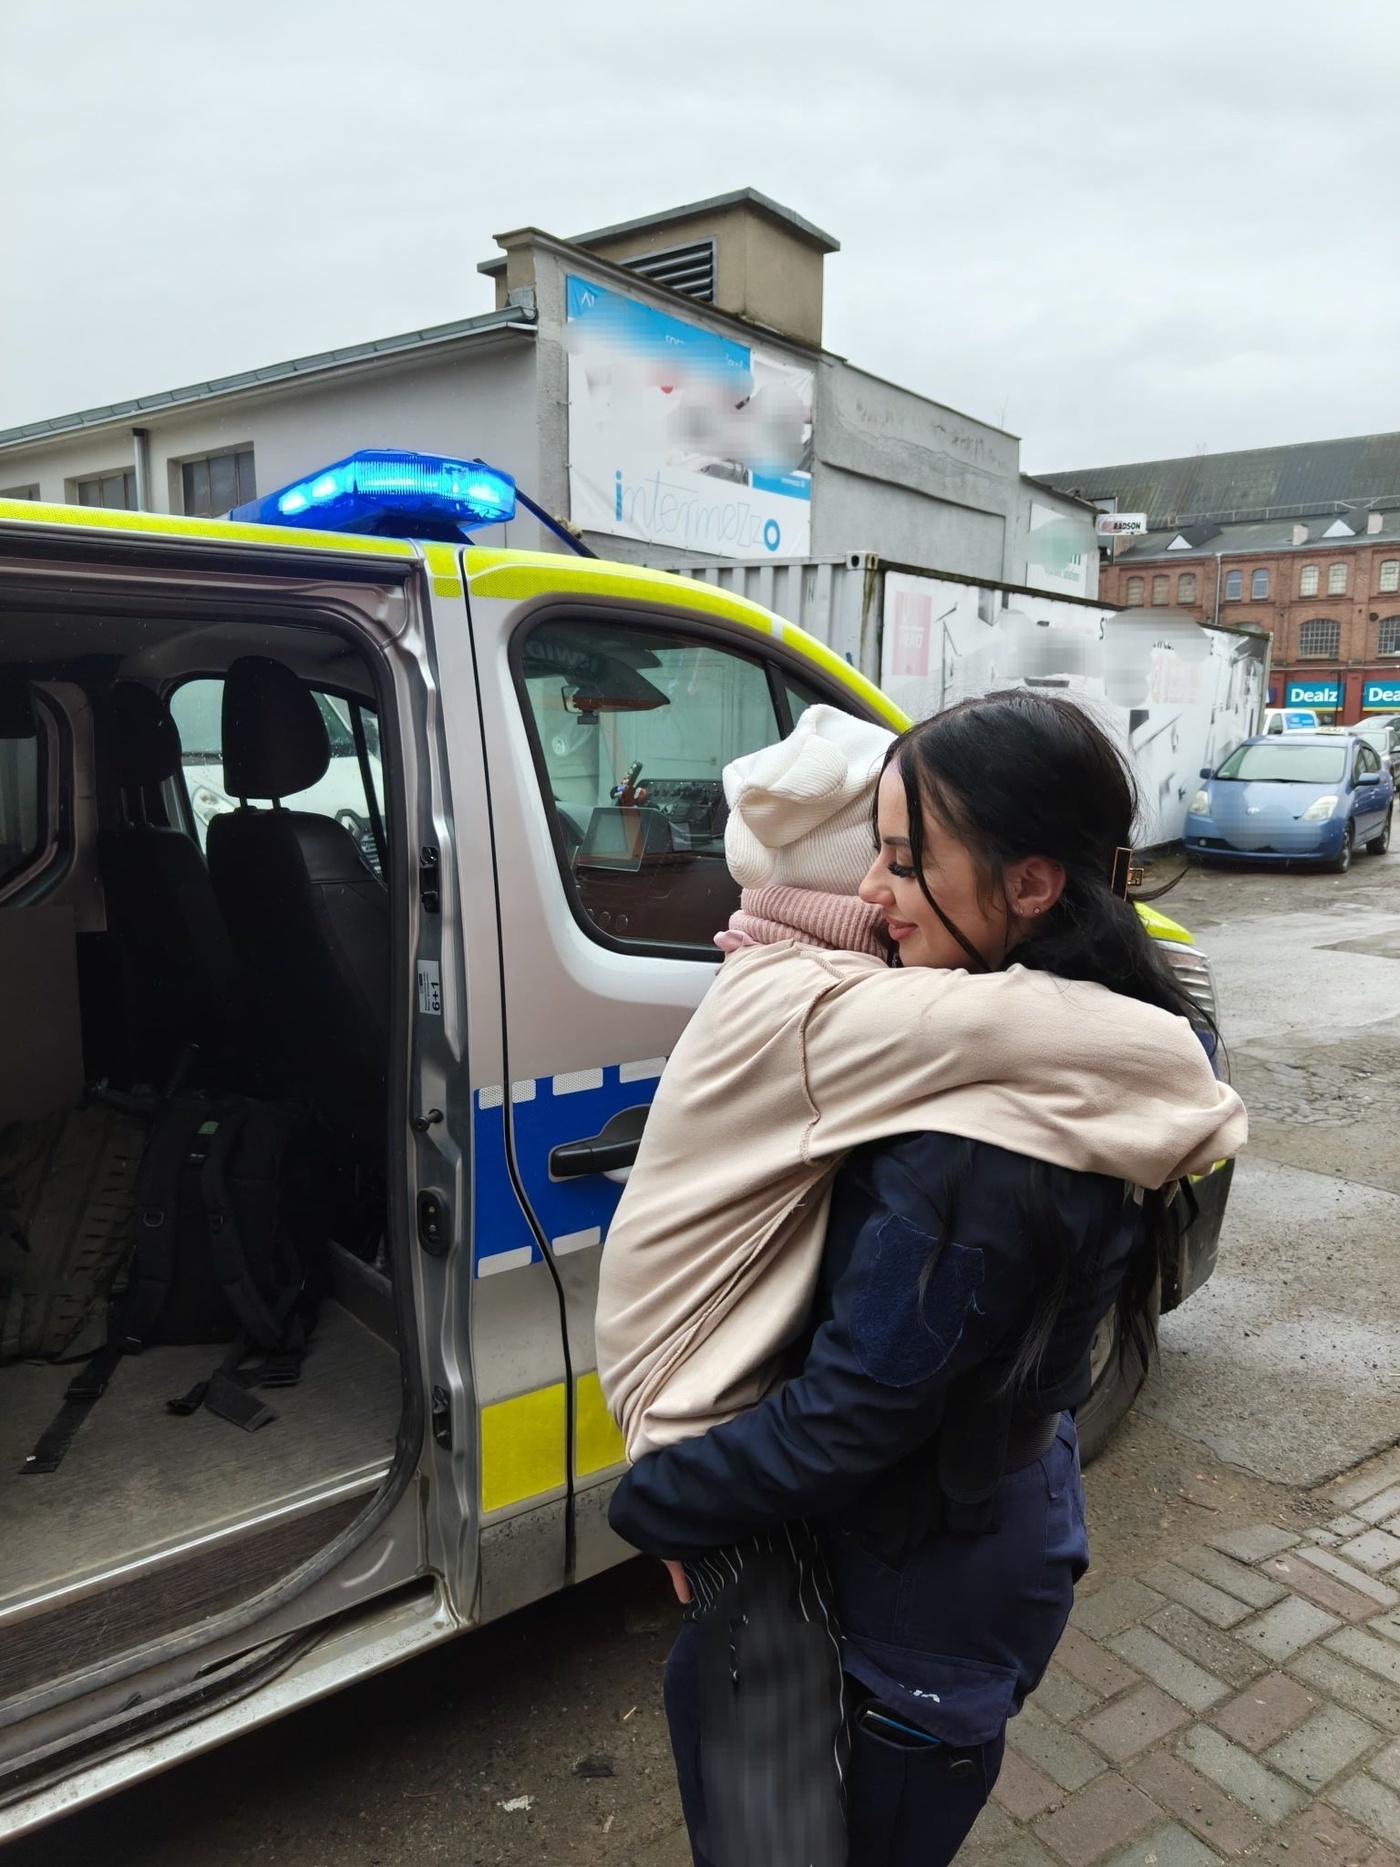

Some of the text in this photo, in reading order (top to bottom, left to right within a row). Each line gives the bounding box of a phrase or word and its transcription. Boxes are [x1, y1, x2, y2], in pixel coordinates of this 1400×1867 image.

[1113, 522, 1141, 530] RADSON
[1291, 688, 1338, 702] Dealz
[1368, 687, 1400, 702] Dea
[431, 982, 440, 1011] 6+1
